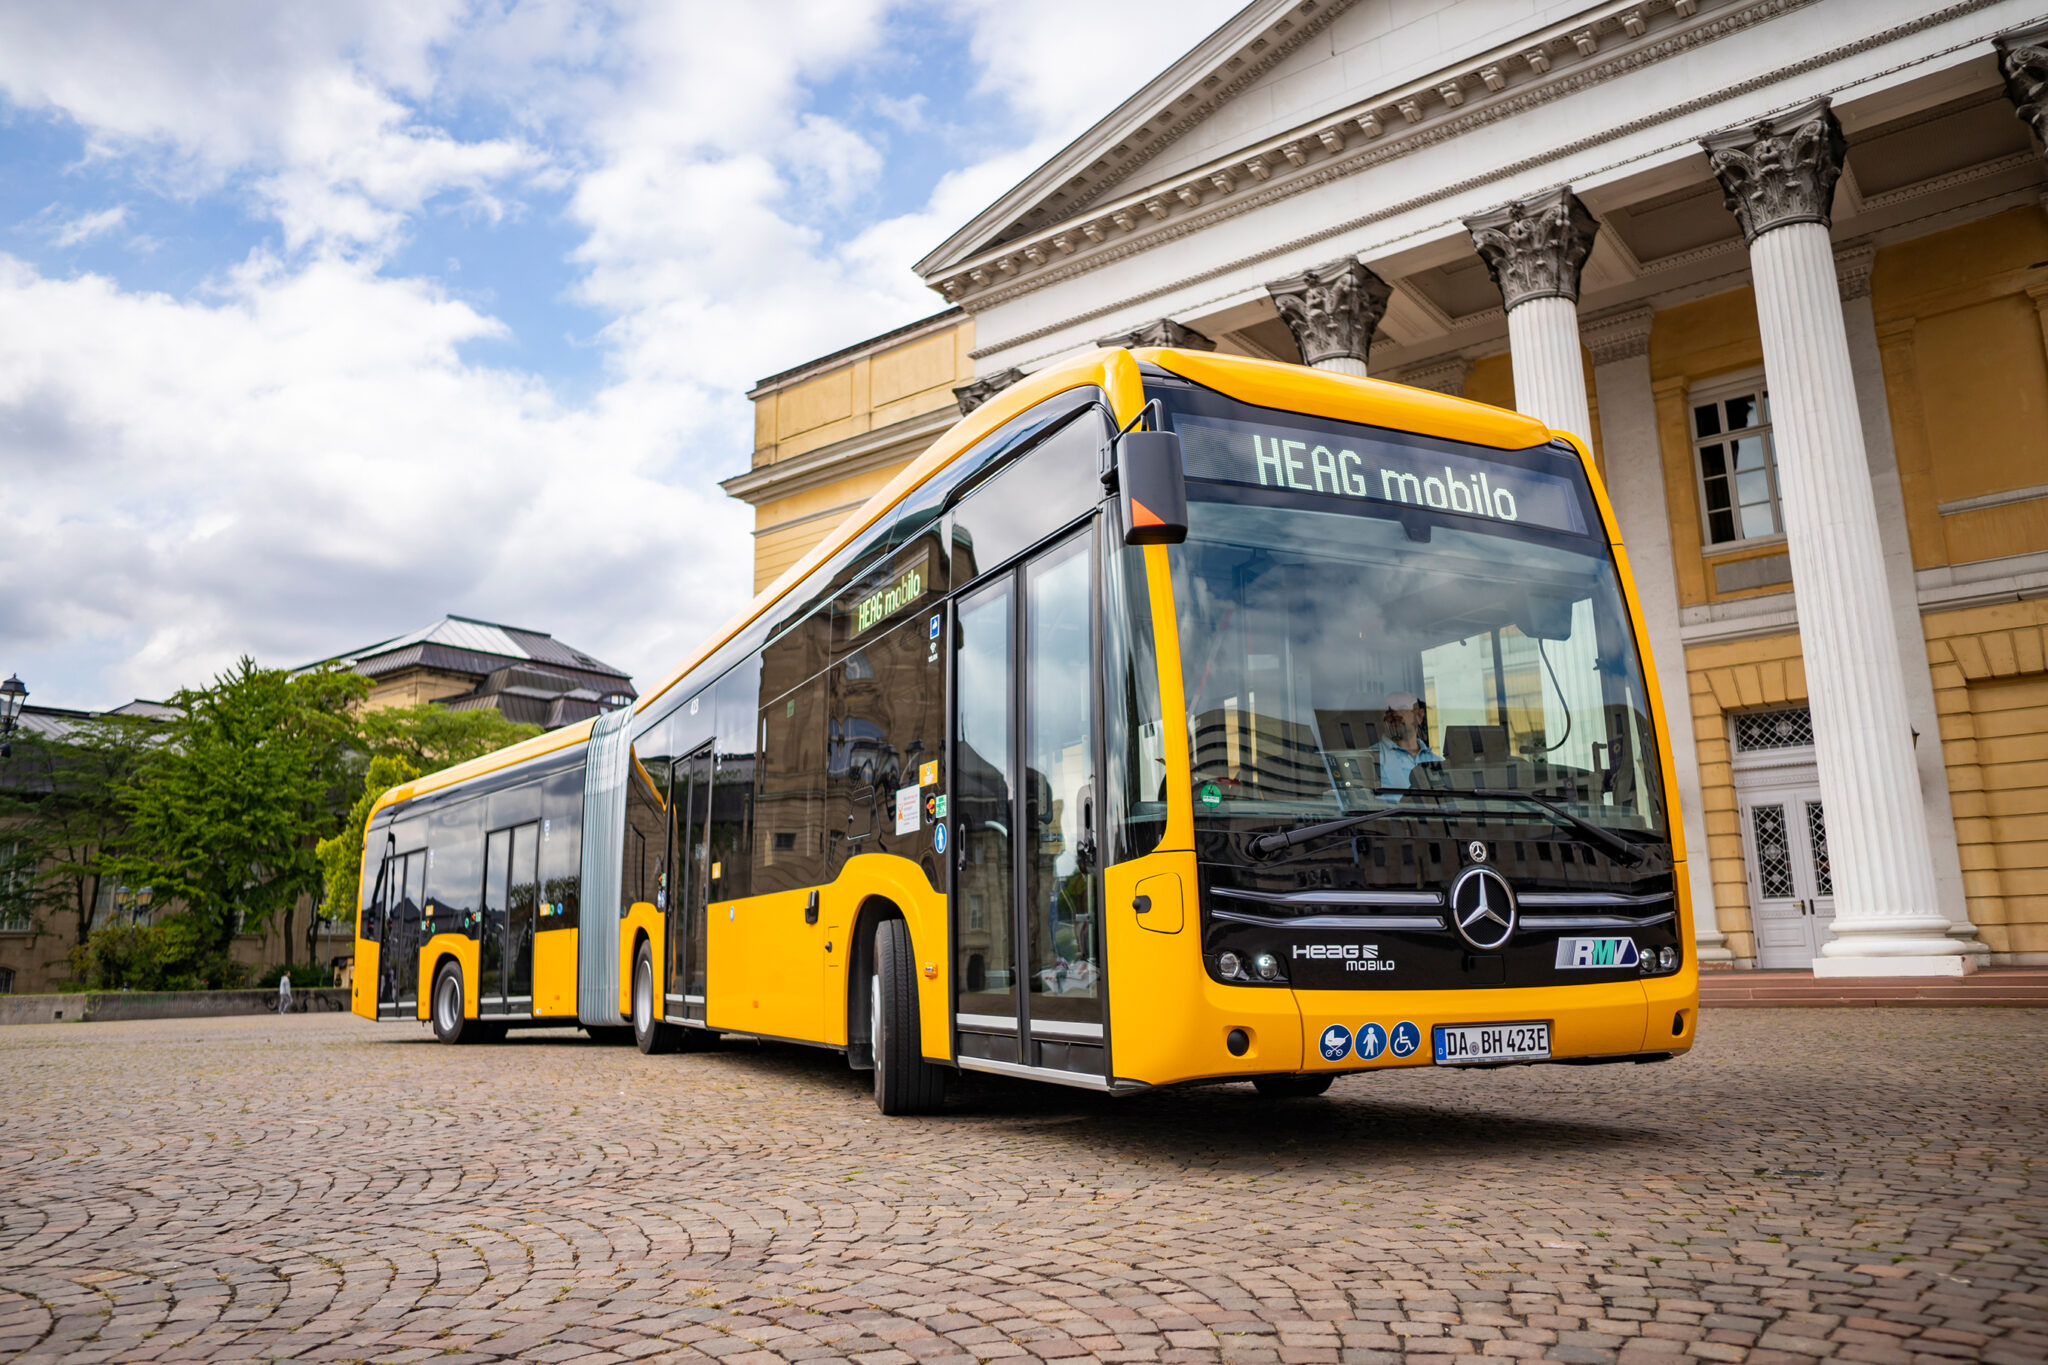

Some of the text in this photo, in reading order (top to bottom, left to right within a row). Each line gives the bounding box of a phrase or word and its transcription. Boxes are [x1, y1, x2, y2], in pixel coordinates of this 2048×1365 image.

[1253, 434, 1518, 521] HEAG mobilo
[858, 569, 920, 632] HEAG mobilo
[1346, 960, 1395, 972] MOBILO
[1573, 939, 1630, 966] RMV
[1446, 1027, 1548, 1056] DA BH 423E
